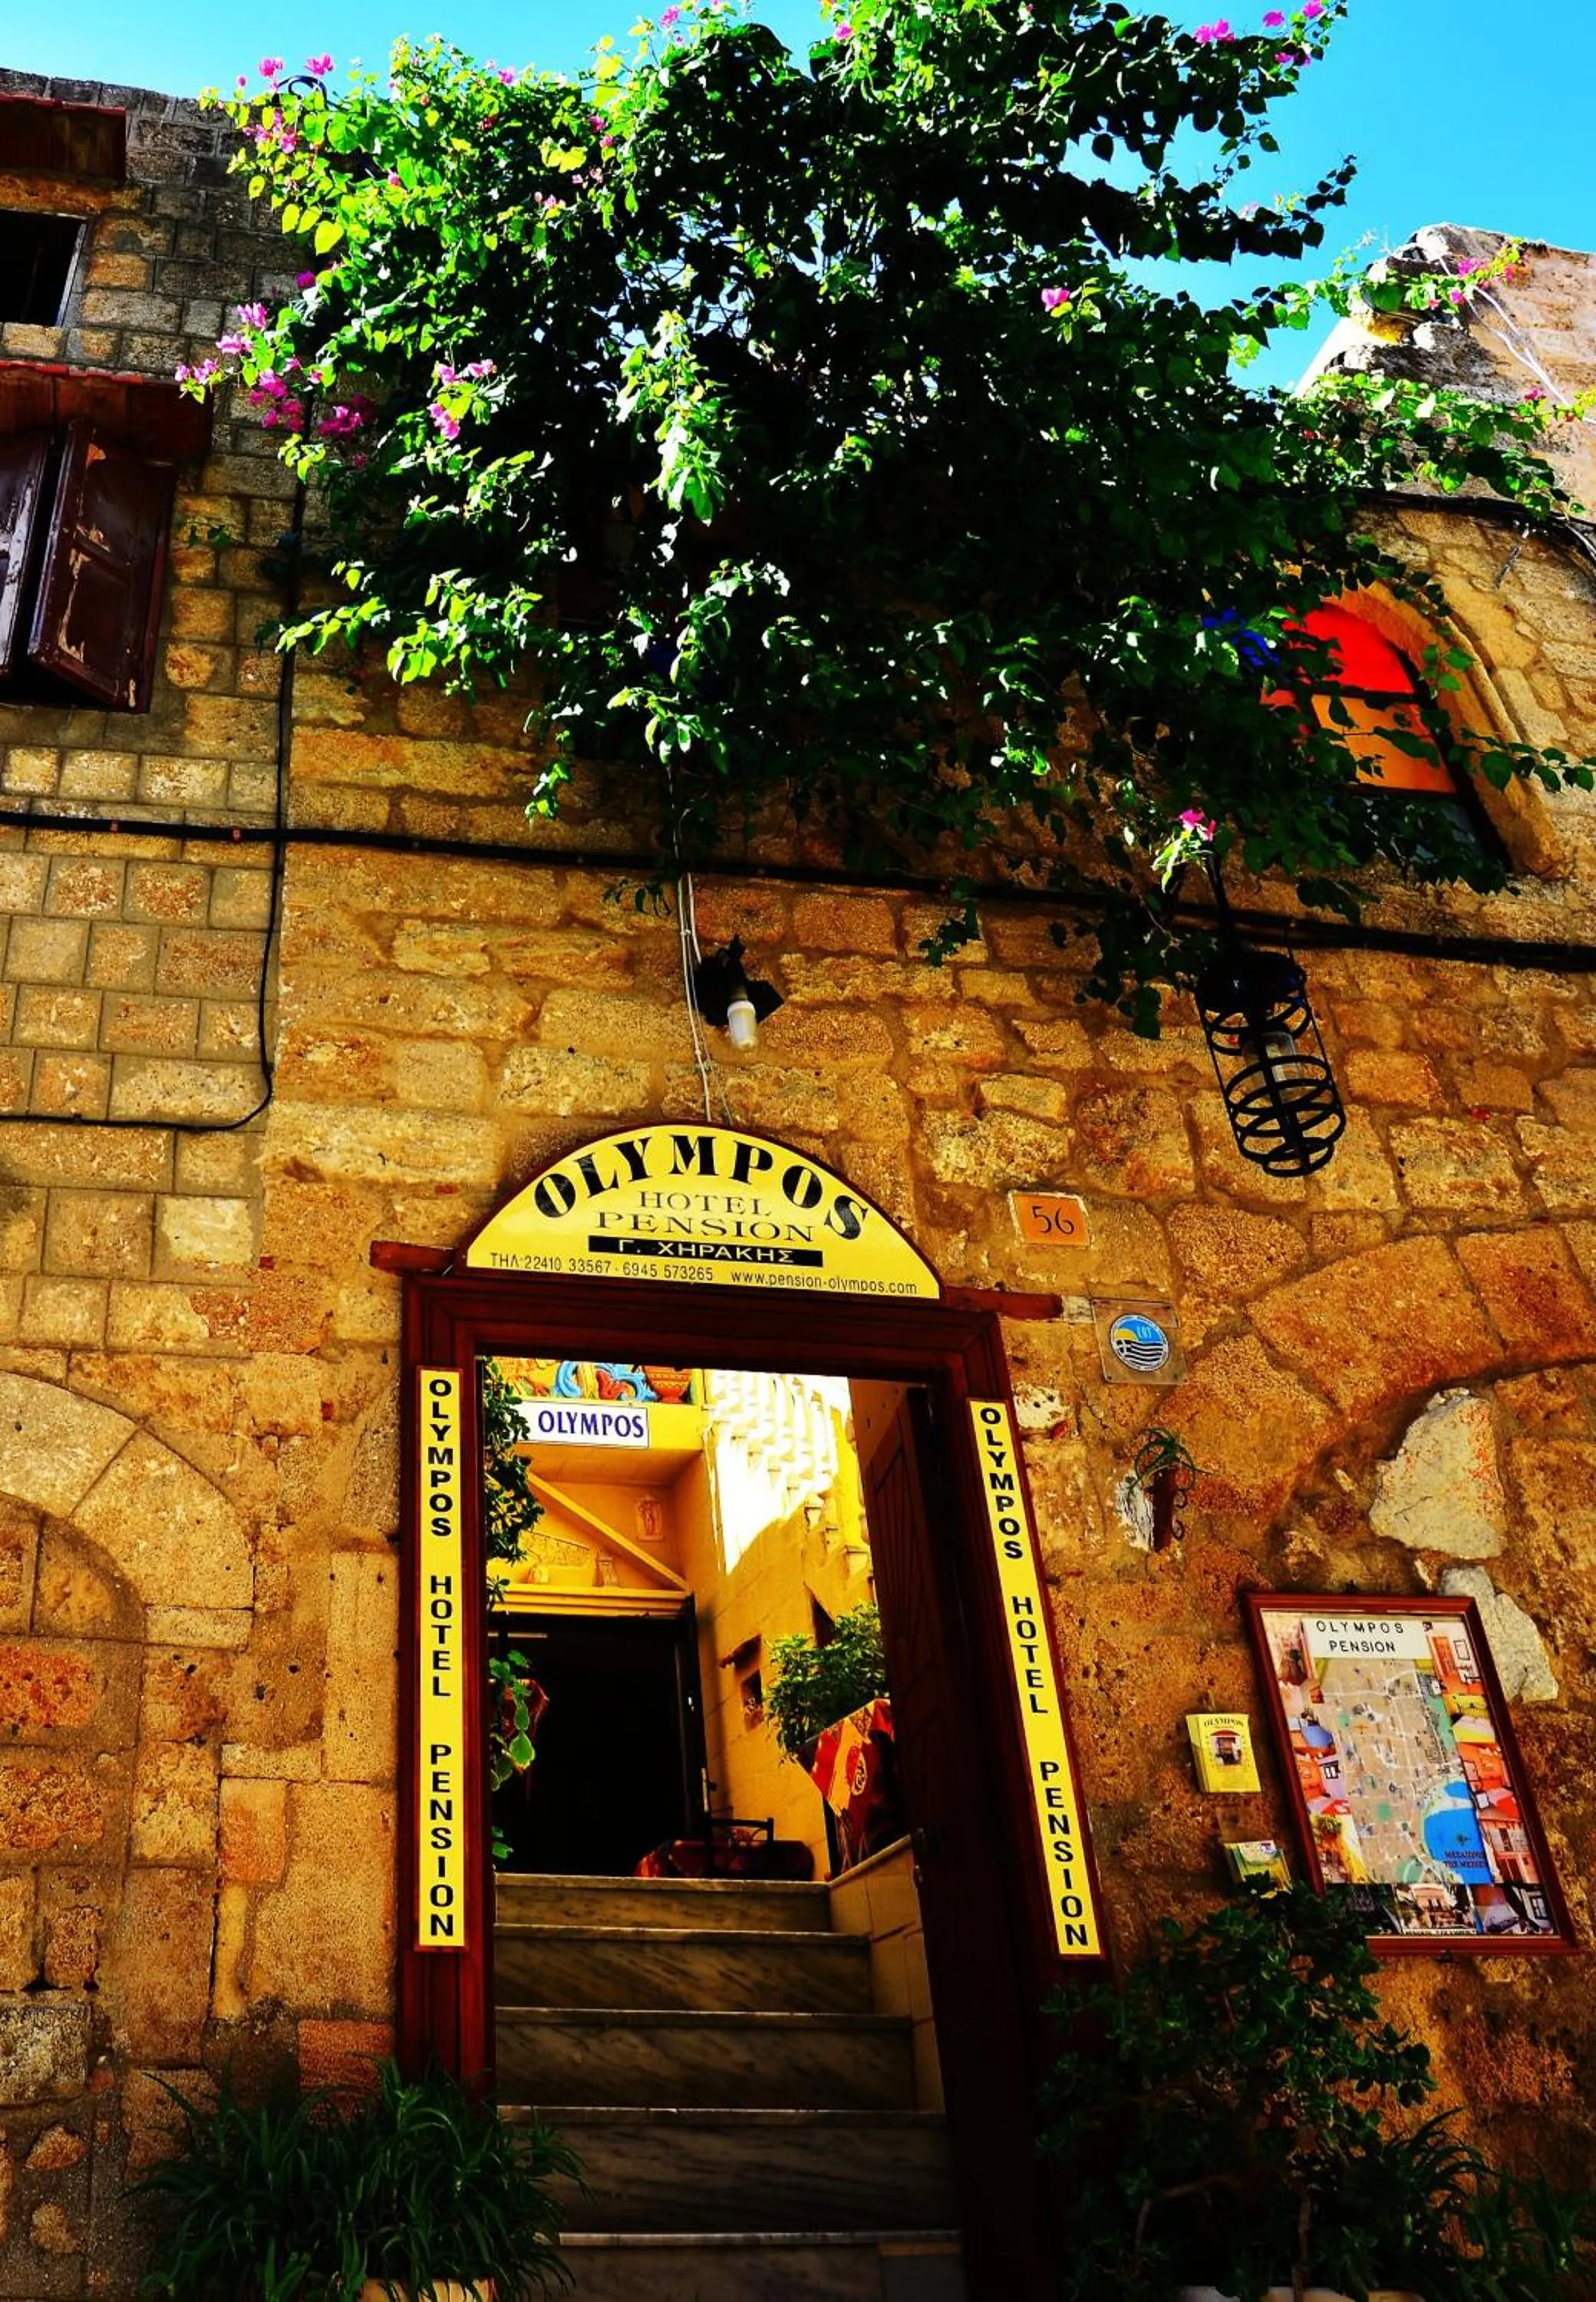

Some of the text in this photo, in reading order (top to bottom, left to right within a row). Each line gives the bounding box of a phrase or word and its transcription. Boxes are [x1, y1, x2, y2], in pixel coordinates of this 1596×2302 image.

[534, 1134, 870, 1241] OLYMPOS
[639, 1191, 772, 1216] HOTEL
[595, 1212, 813, 1242] PENSION
[1031, 1205, 1074, 1235] 56
[658, 1242, 794, 1264] ΧΗΡΑΚΗΣ
[569, 1258, 611, 1274] 33567
[623, 1261, 658, 1278] 6945
[664, 1265, 713, 1281] 573265
[730, 1270, 917, 1294] www.pension-olympos.com
[538, 1410, 644, 1438] OLYMPOS
[1316, 1620, 1403, 1634] OLYMPOS
[428, 1379, 453, 1937] OLYMPOS HOTEL PENSION
[1328, 1640, 1396, 1652] PENSION
[980, 1407, 1088, 1947] OLYMPOS HOTEL PENSION
